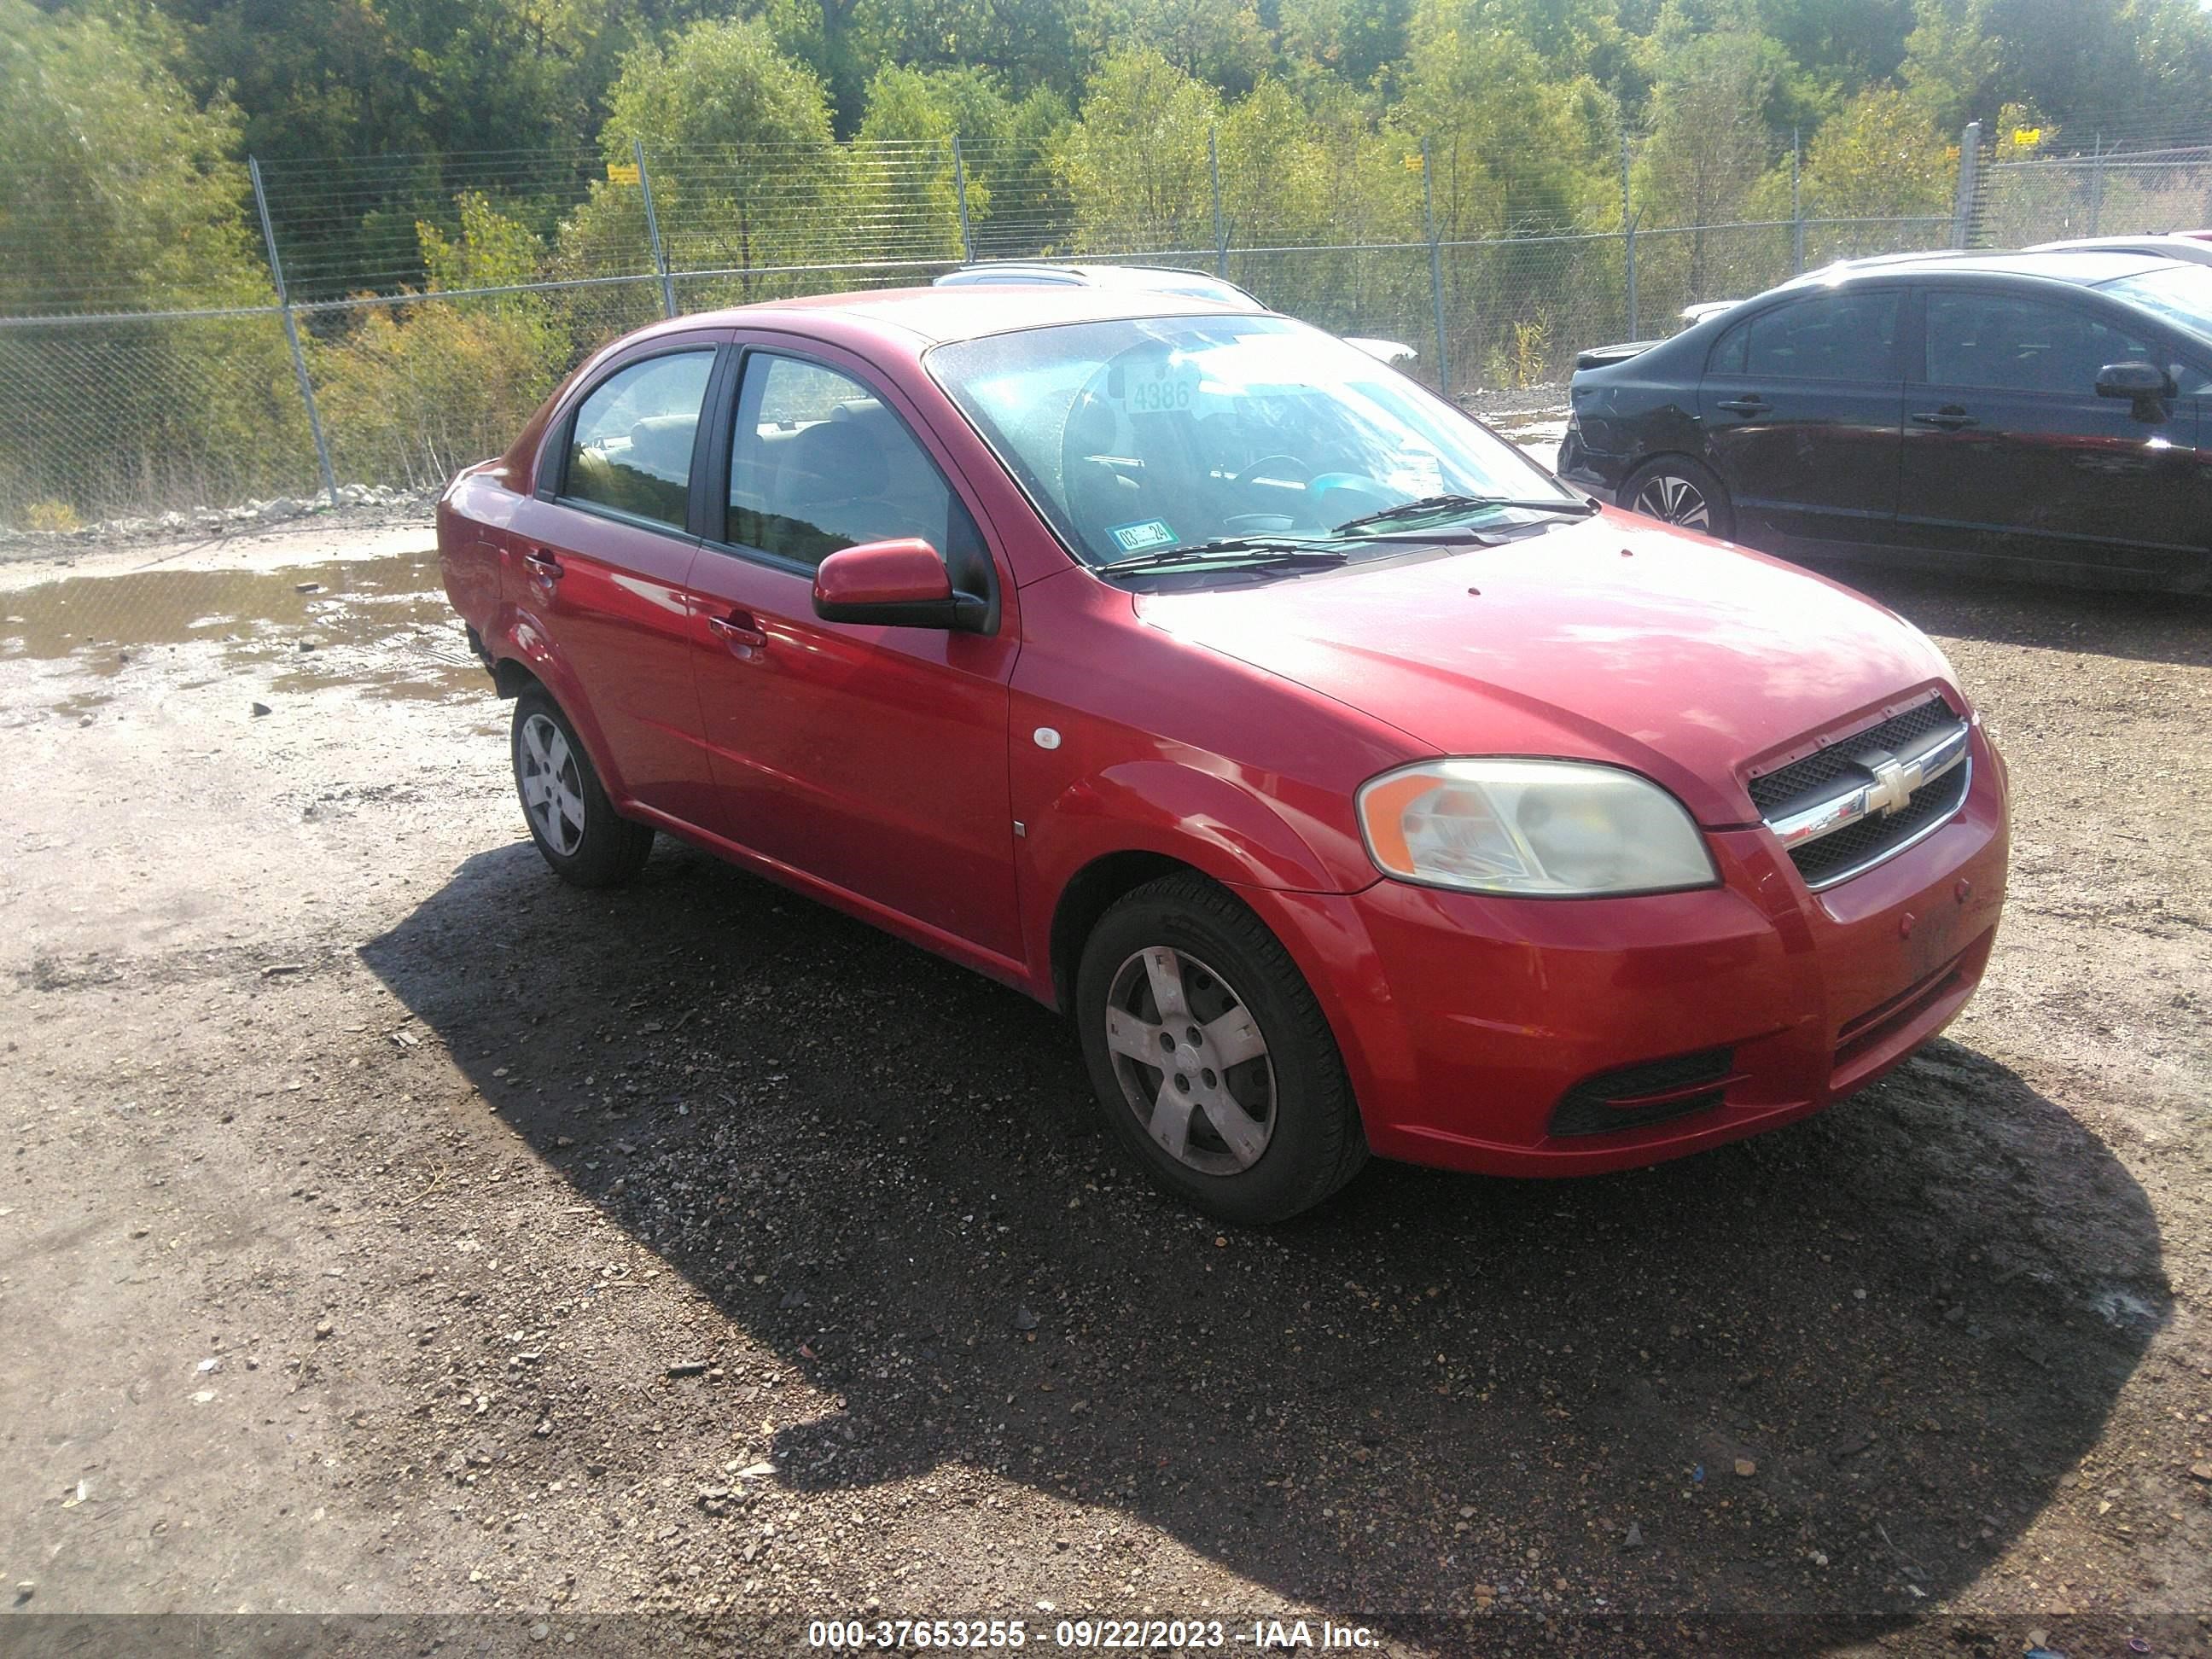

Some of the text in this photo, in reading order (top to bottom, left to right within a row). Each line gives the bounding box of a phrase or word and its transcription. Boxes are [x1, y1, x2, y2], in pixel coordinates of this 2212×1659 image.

[1134, 380, 1190, 410] 4386
[1119, 523, 1168, 547] 03 24
